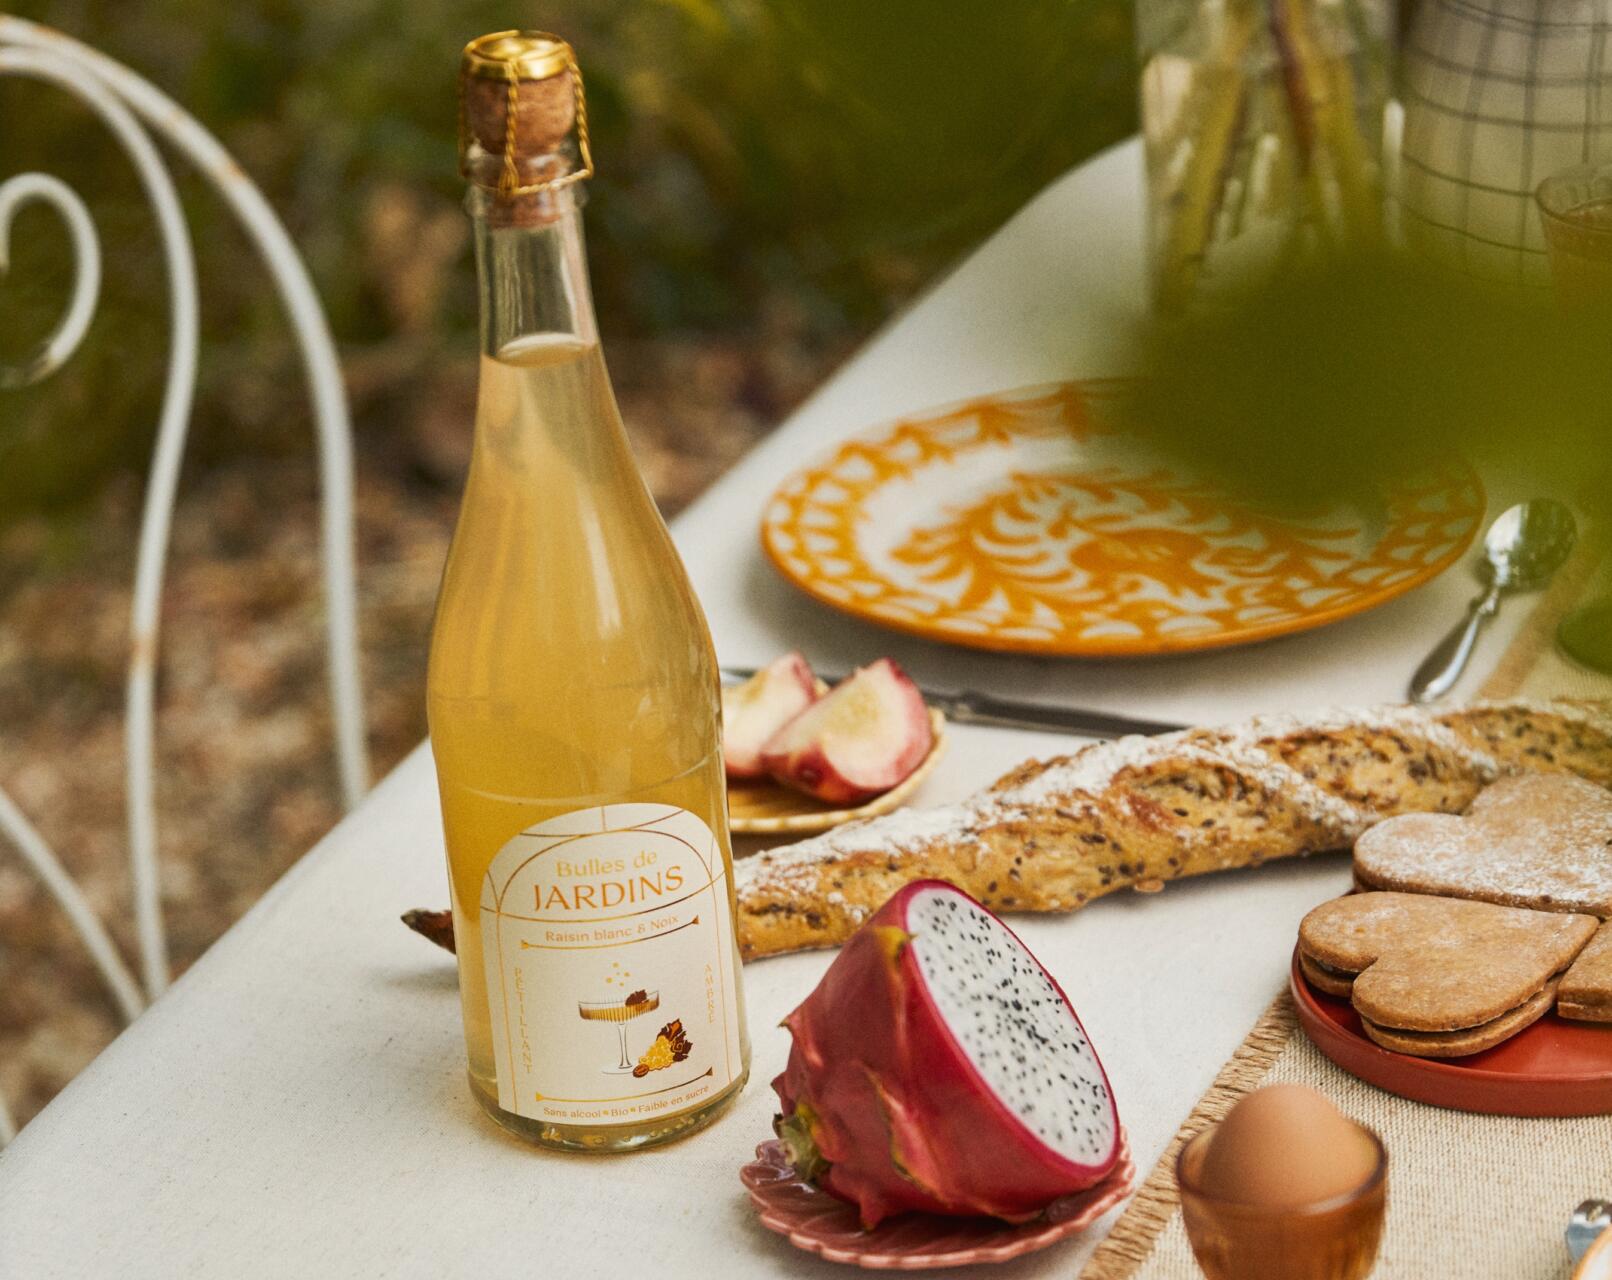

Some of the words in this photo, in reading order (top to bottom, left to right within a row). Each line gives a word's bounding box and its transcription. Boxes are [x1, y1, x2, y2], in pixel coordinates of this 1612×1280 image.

[555, 857, 625, 878] Bulles
[633, 850, 658, 869] de
[533, 865, 684, 912] JARDINS
[545, 929, 590, 942] Raisin
[594, 925, 632, 940] blanc
[636, 923, 646, 934] &
[650, 915, 679, 930] Noix
[543, 1106, 567, 1118] Sans
[570, 1109, 601, 1119] alcool
[611, 1108, 629, 1117] Bio
[638, 1101, 668, 1114] Faible
[671, 1096, 683, 1106] en
[685, 1085, 709, 1102] sucre
